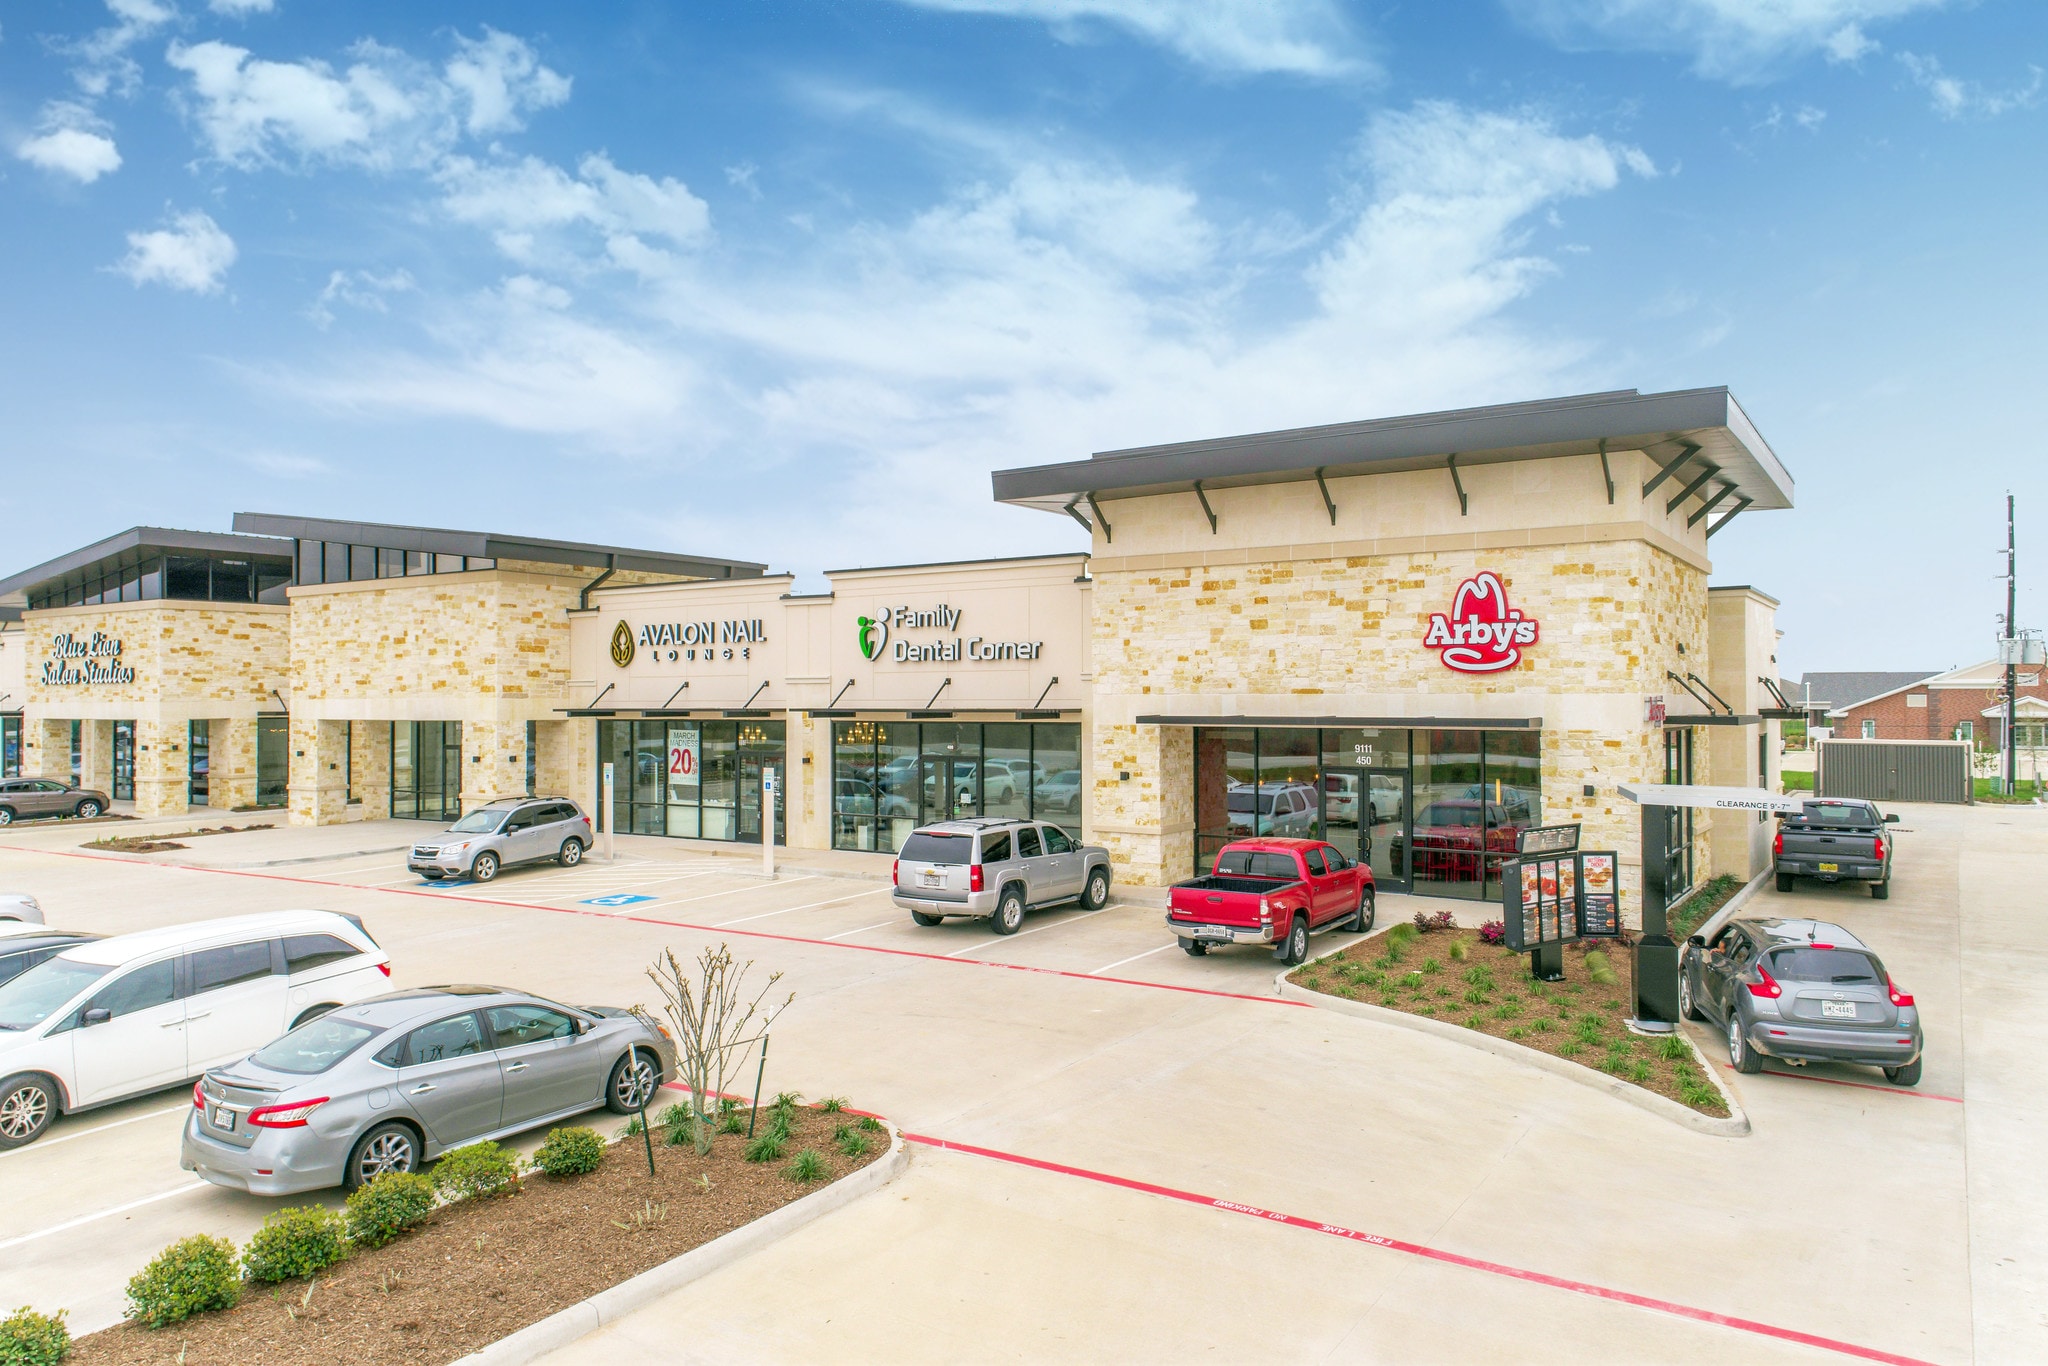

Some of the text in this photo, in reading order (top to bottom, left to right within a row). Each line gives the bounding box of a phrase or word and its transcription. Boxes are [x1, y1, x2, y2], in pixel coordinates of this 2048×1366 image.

[893, 604, 962, 631] Family
[52, 631, 123, 659] Blue Lion
[638, 619, 767, 646] AVALON NAIL
[1425, 611, 1536, 653] Arby's
[652, 647, 750, 662] LOUNGE
[893, 636, 1044, 662] Dental Corner
[41, 657, 136, 685] Salon Studios
[670, 739, 699, 748] MADNESS
[673, 731, 696, 740] MARCH
[670, 748, 692, 775] 20
[1354, 744, 1373, 754] 9111
[1355, 756, 1372, 765] 450
[1716, 800, 1768, 809] CLEARANCE
[1212, 1199, 1396, 1247] FIRE LANE NO PARKING
